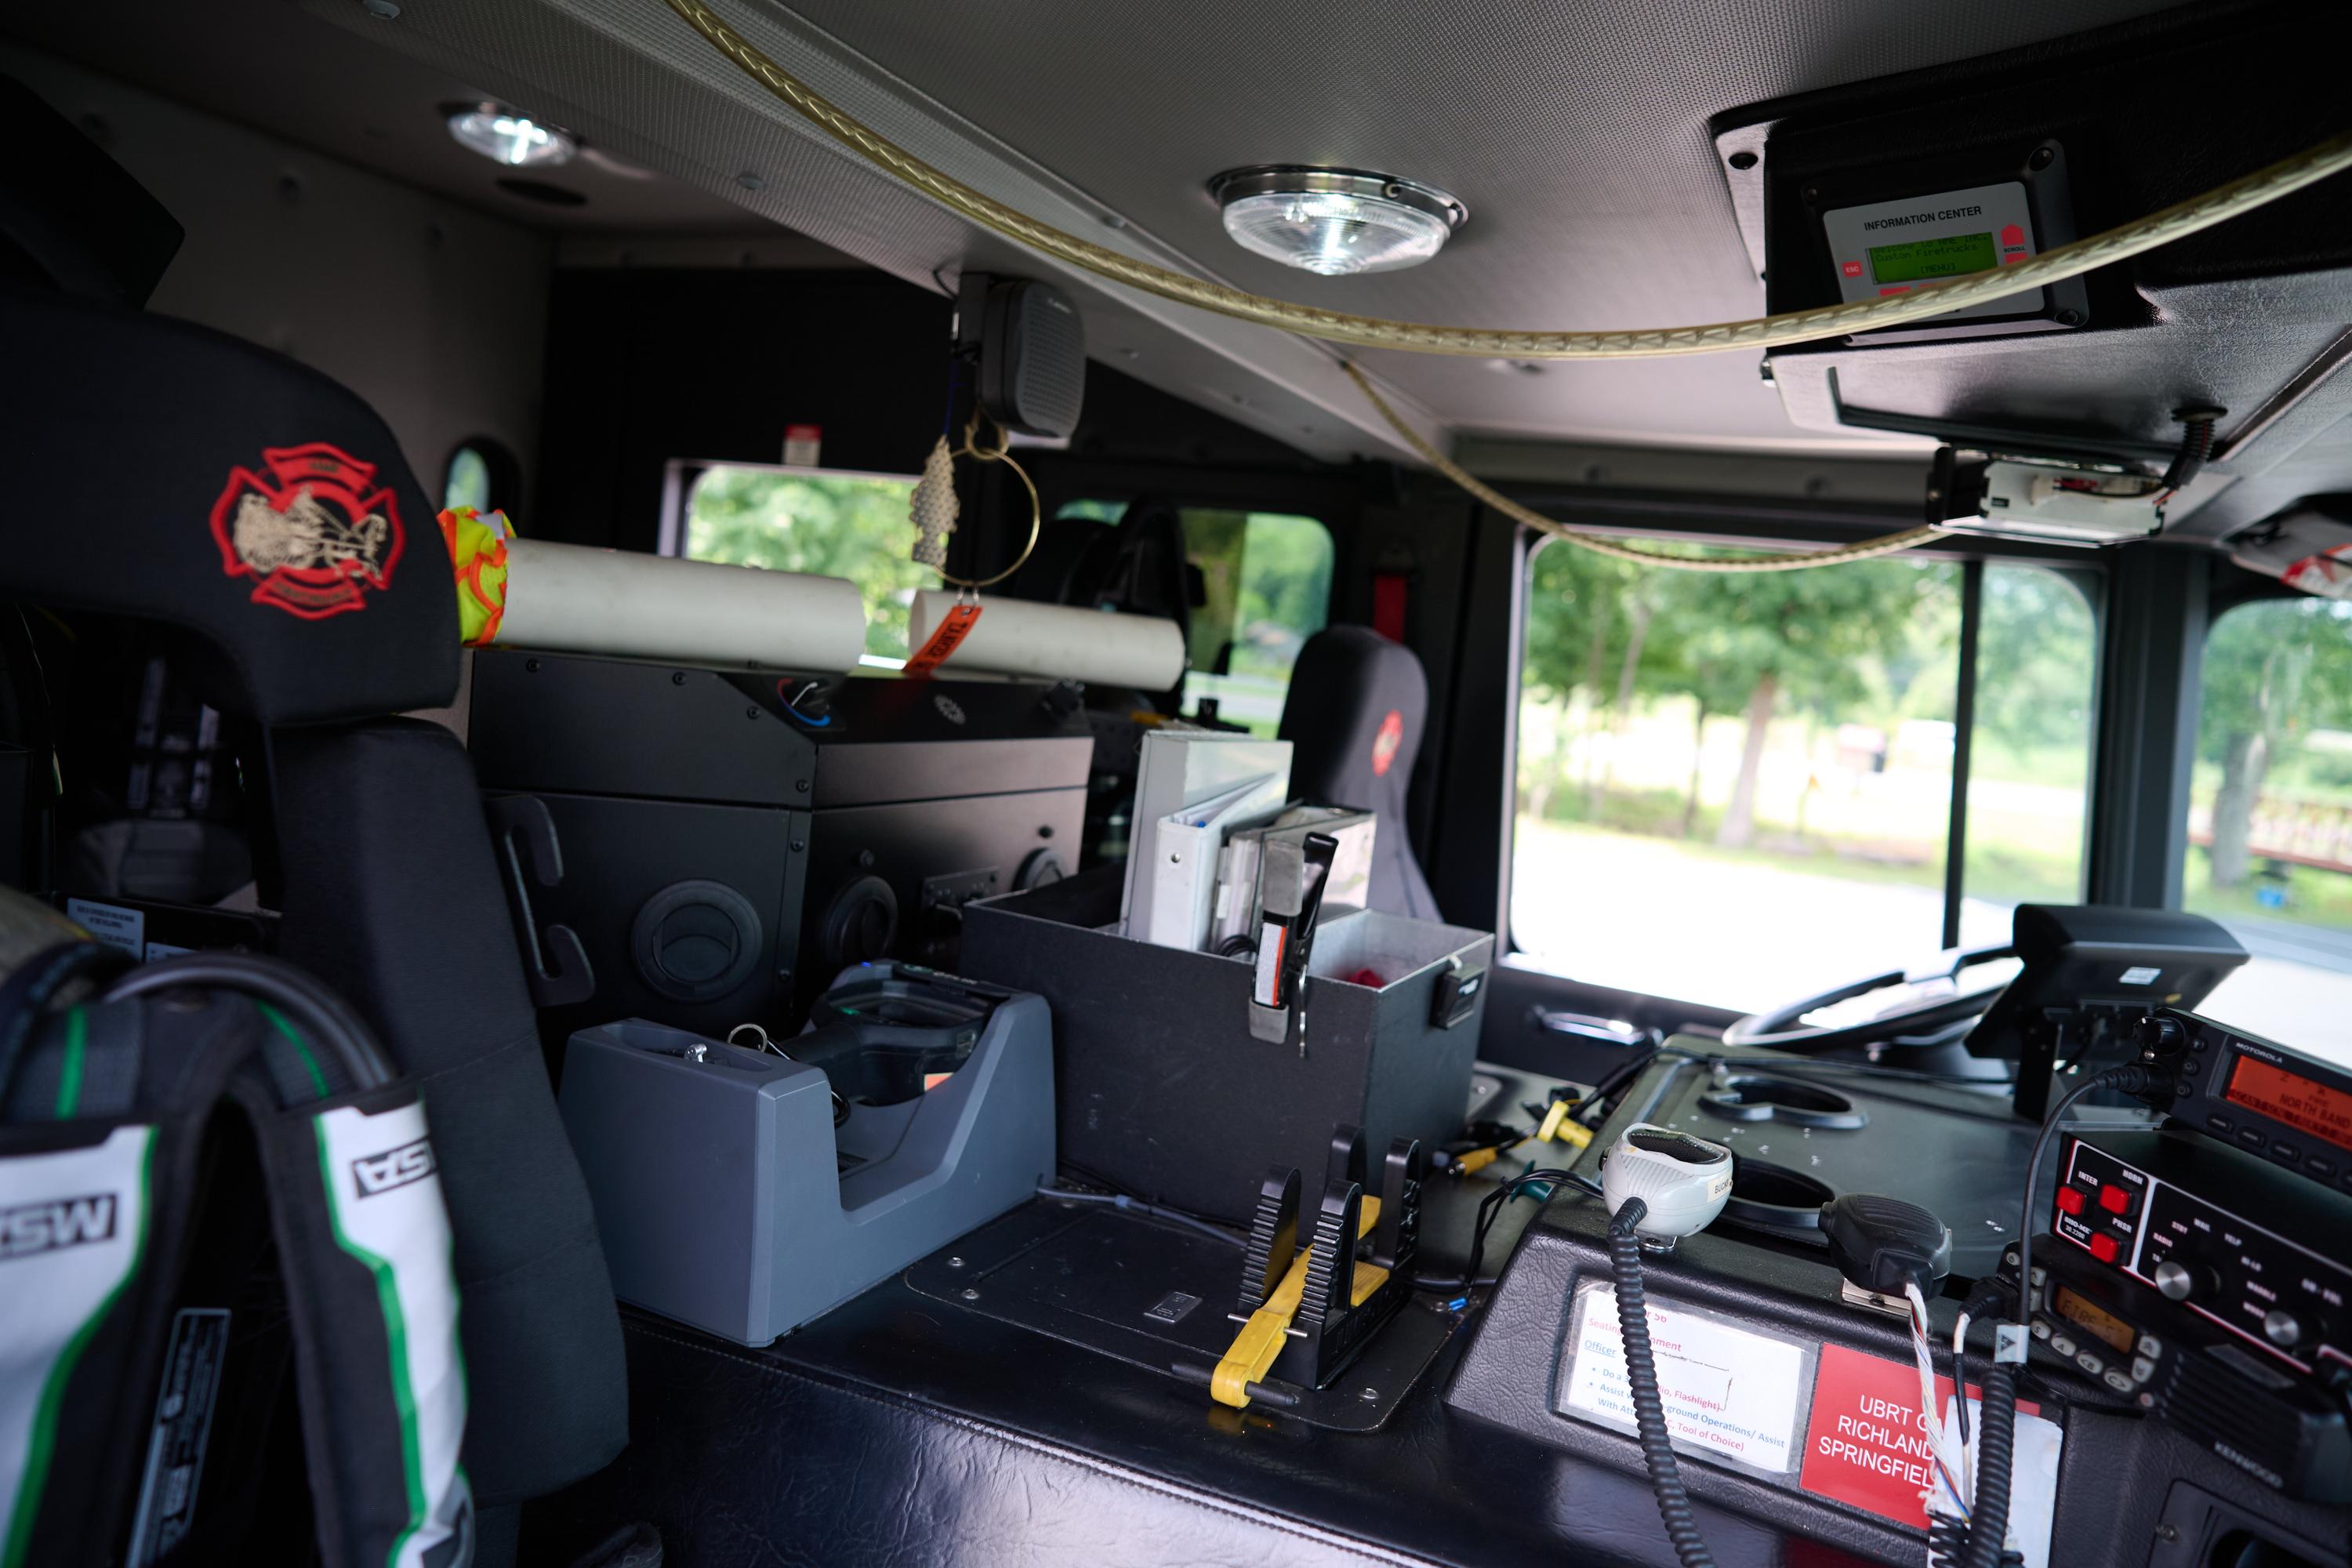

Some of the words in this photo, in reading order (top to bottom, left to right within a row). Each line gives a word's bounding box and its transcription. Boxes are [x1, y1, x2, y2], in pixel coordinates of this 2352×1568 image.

[1864, 212, 1936, 232] INFORMATION
[1937, 205, 1983, 221] CENTER
[1916, 245, 1978, 258] Firetrucks
[2234, 1042, 2284, 1064] MOTOROLA
[2279, 1093, 2317, 1115] NORTH
[2320, 1108, 2351, 1129] BAND
[354, 1142, 437, 1193] SA
[2078, 1171, 2099, 1186] INTER
[0, 1199, 112, 1253] MS
[1584, 1339, 1617, 1357] Officer
[2056, 1344, 2065, 1352] A
[1602, 1369, 1615, 1378] Do
[1675, 1389, 1721, 1412] Flashlight)
[1598, 1397, 1618, 1411] With
[1678, 1422, 1697, 1436] Tool
[1698, 1430, 1710, 1439] of
[1710, 1433, 1744, 1451] Choice)
[1599, 1384, 1624, 1397] Assist
[1700, 1413, 1756, 1439] Operations/
[1758, 1432, 1786, 1449] Assist
[1860, 1394, 1913, 1426] UBRT
[1818, 1436, 1933, 1489] SPRINGFIEL
[2214, 1440, 2284, 1490] KENWOOD
